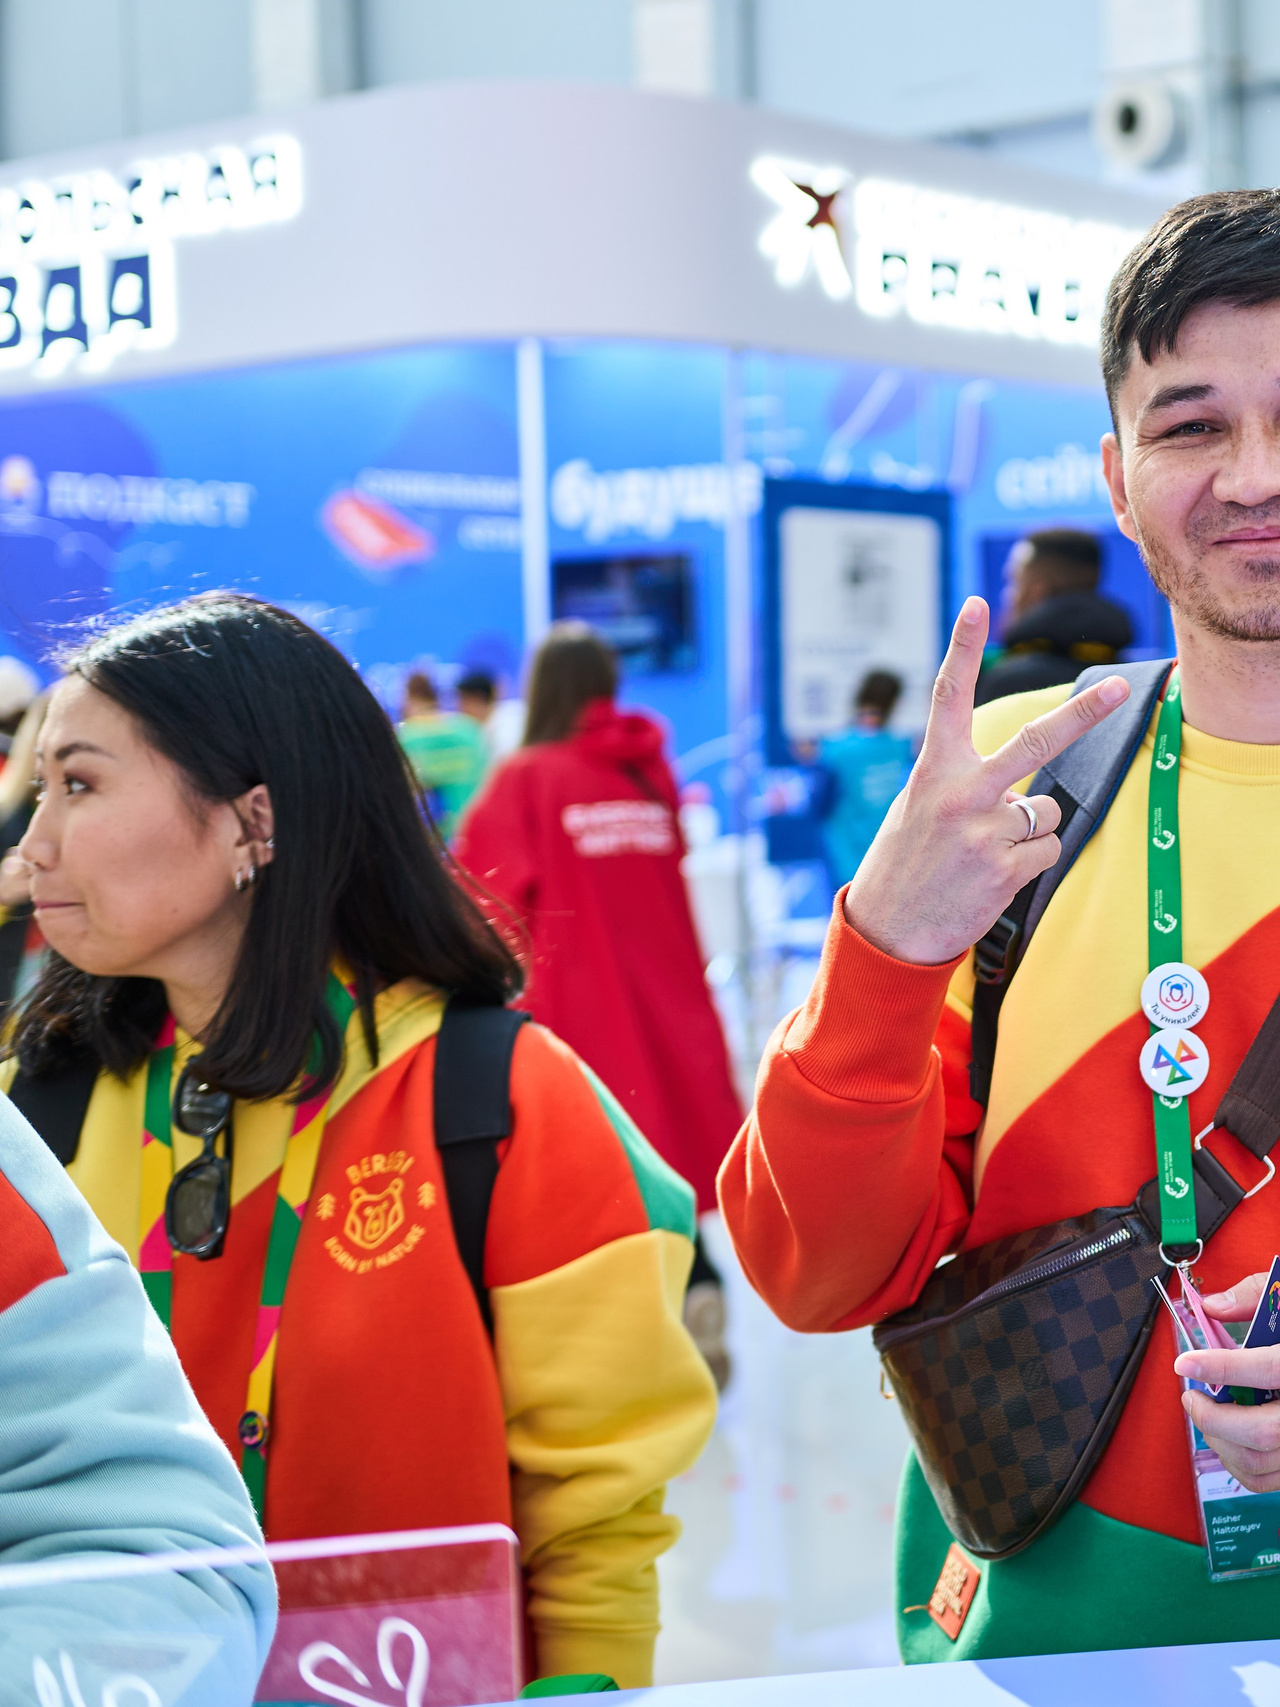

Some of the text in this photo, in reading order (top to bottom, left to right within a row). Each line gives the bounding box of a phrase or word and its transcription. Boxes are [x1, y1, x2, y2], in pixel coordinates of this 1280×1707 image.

[1150, 1002, 1202, 1025] Ты уникален!
[345, 1150, 415, 1186] BEREGI
[324, 1223, 427, 1274] BORN BY NATURE
[1212, 1514, 1242, 1525] Alisher
[1213, 1523, 1261, 1535] Haltorayev
